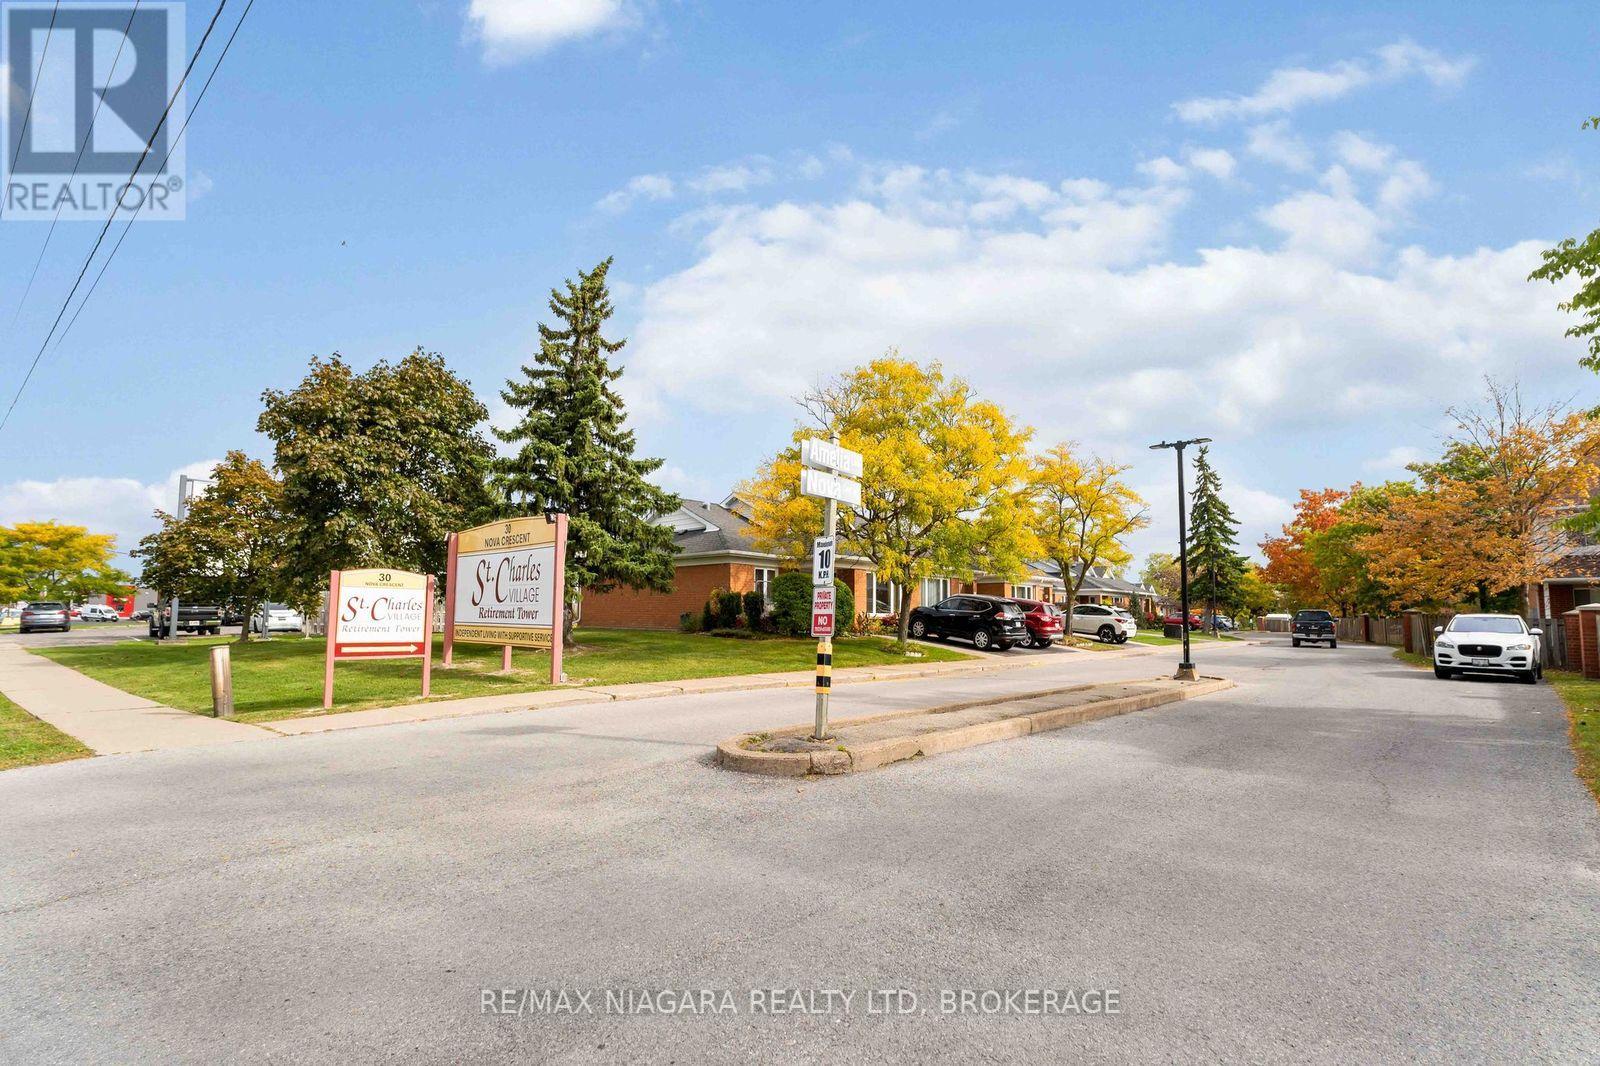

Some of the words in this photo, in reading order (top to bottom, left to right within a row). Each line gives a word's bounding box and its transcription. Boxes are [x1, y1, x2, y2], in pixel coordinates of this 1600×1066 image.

[810, 438, 850, 471] Amelia
[807, 469, 841, 500] Nova
[505, 524, 512, 534] 30
[484, 537, 500, 548] NOVA
[501, 532, 531, 546] CRESCENT
[818, 549, 831, 569] 10
[378, 573, 391, 582] 30
[472, 559, 495, 606] St.
[495, 554, 541, 603] Charles
[509, 587, 540, 603] VILLAGE
[817, 591, 832, 600] PRIVATE
[341, 596, 369, 622] St.
[371, 597, 423, 621] Charles
[814, 601, 833, 610] PROPERTY
[387, 613, 422, 621] VILLAGE
[478, 607, 515, 619] Retirement
[517, 607, 539, 620] Tower
[818, 615, 828, 625] NO
[342, 624, 390, 633] Retirement
[396, 625, 420, 633] Tower
[455, 628, 482, 638] INDEPENDENT
[482, 630, 497, 639] LIVING
[497, 631, 508, 640] WITH
[508, 631, 534, 641] SUPPORTIVE
